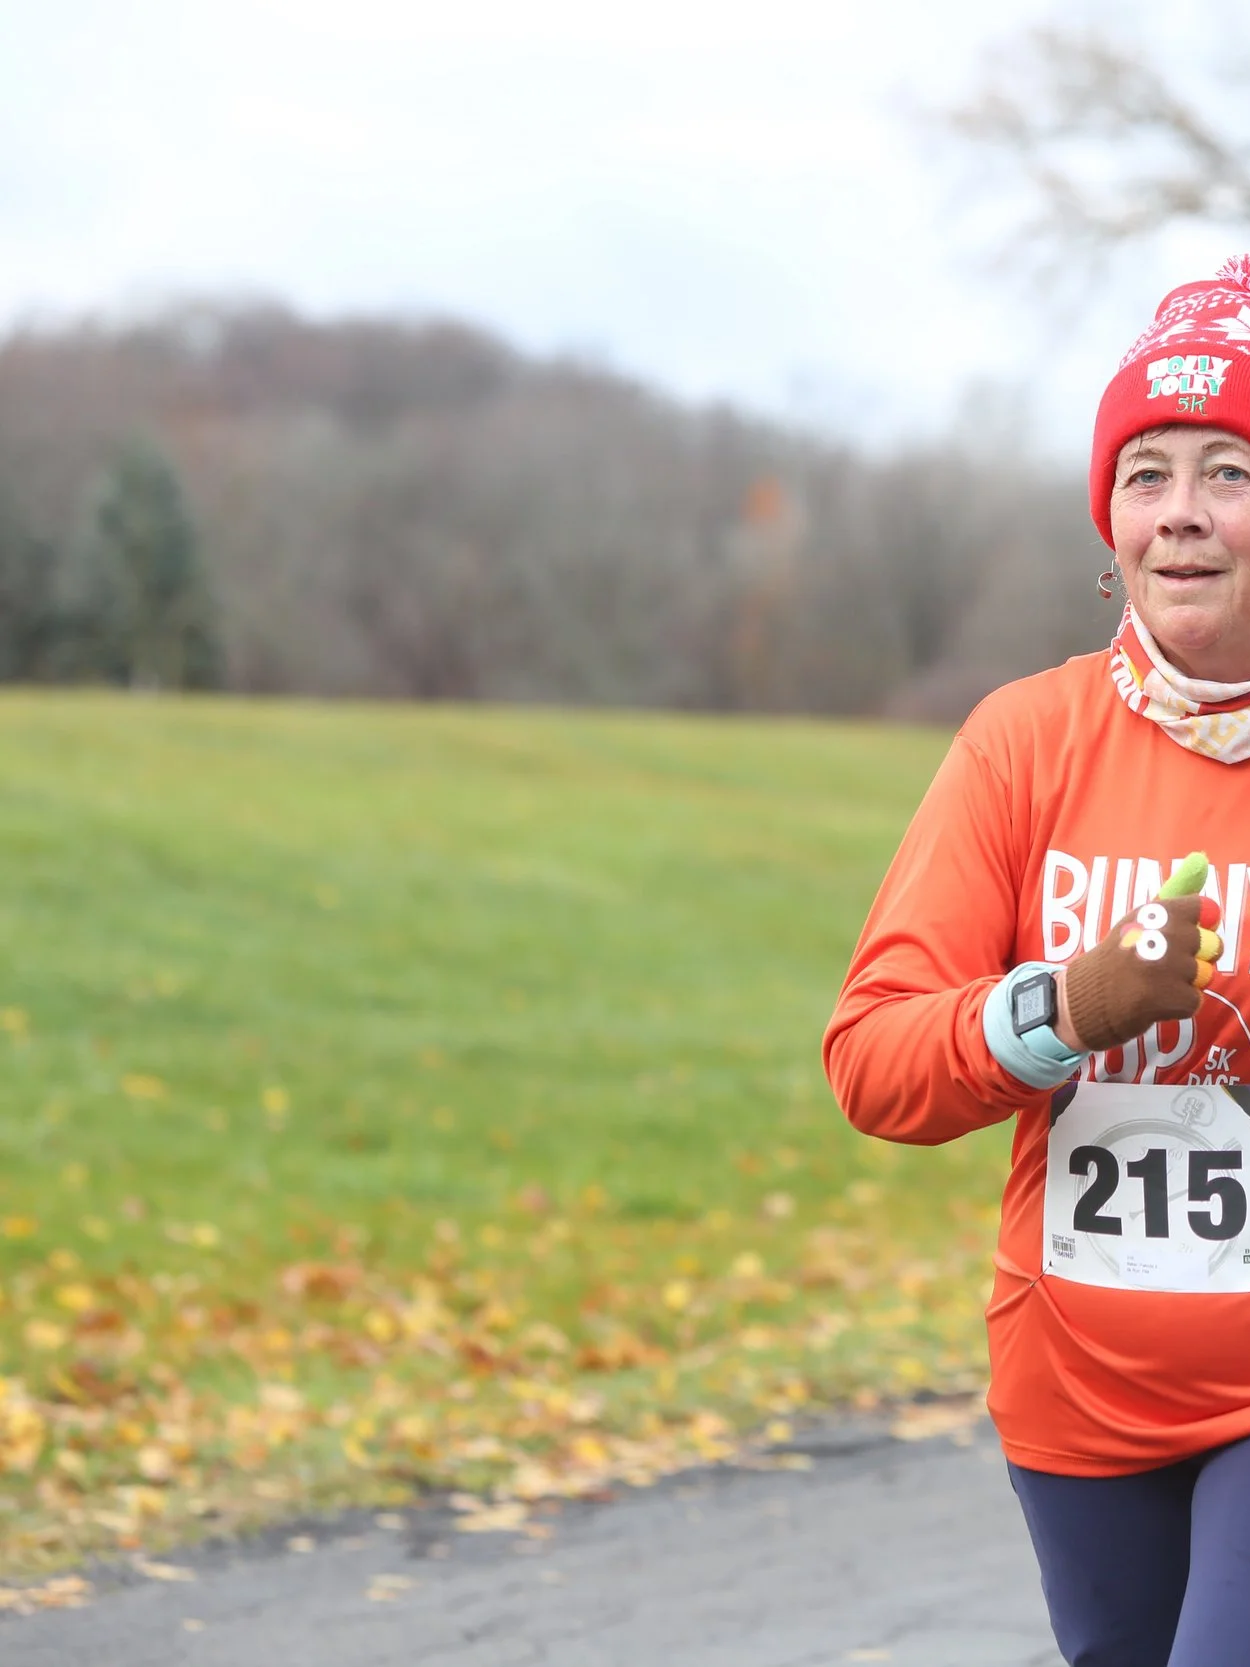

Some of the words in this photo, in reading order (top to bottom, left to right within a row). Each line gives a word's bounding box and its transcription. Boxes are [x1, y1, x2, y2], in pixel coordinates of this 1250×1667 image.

[1147, 355, 1233, 381] HOLLY
[1147, 374, 1226, 399] JOLLY
[1176, 395, 1208, 416] 5K
[1205, 1044, 1238, 1072] 5K
[1069, 1145, 1247, 1241] 215
